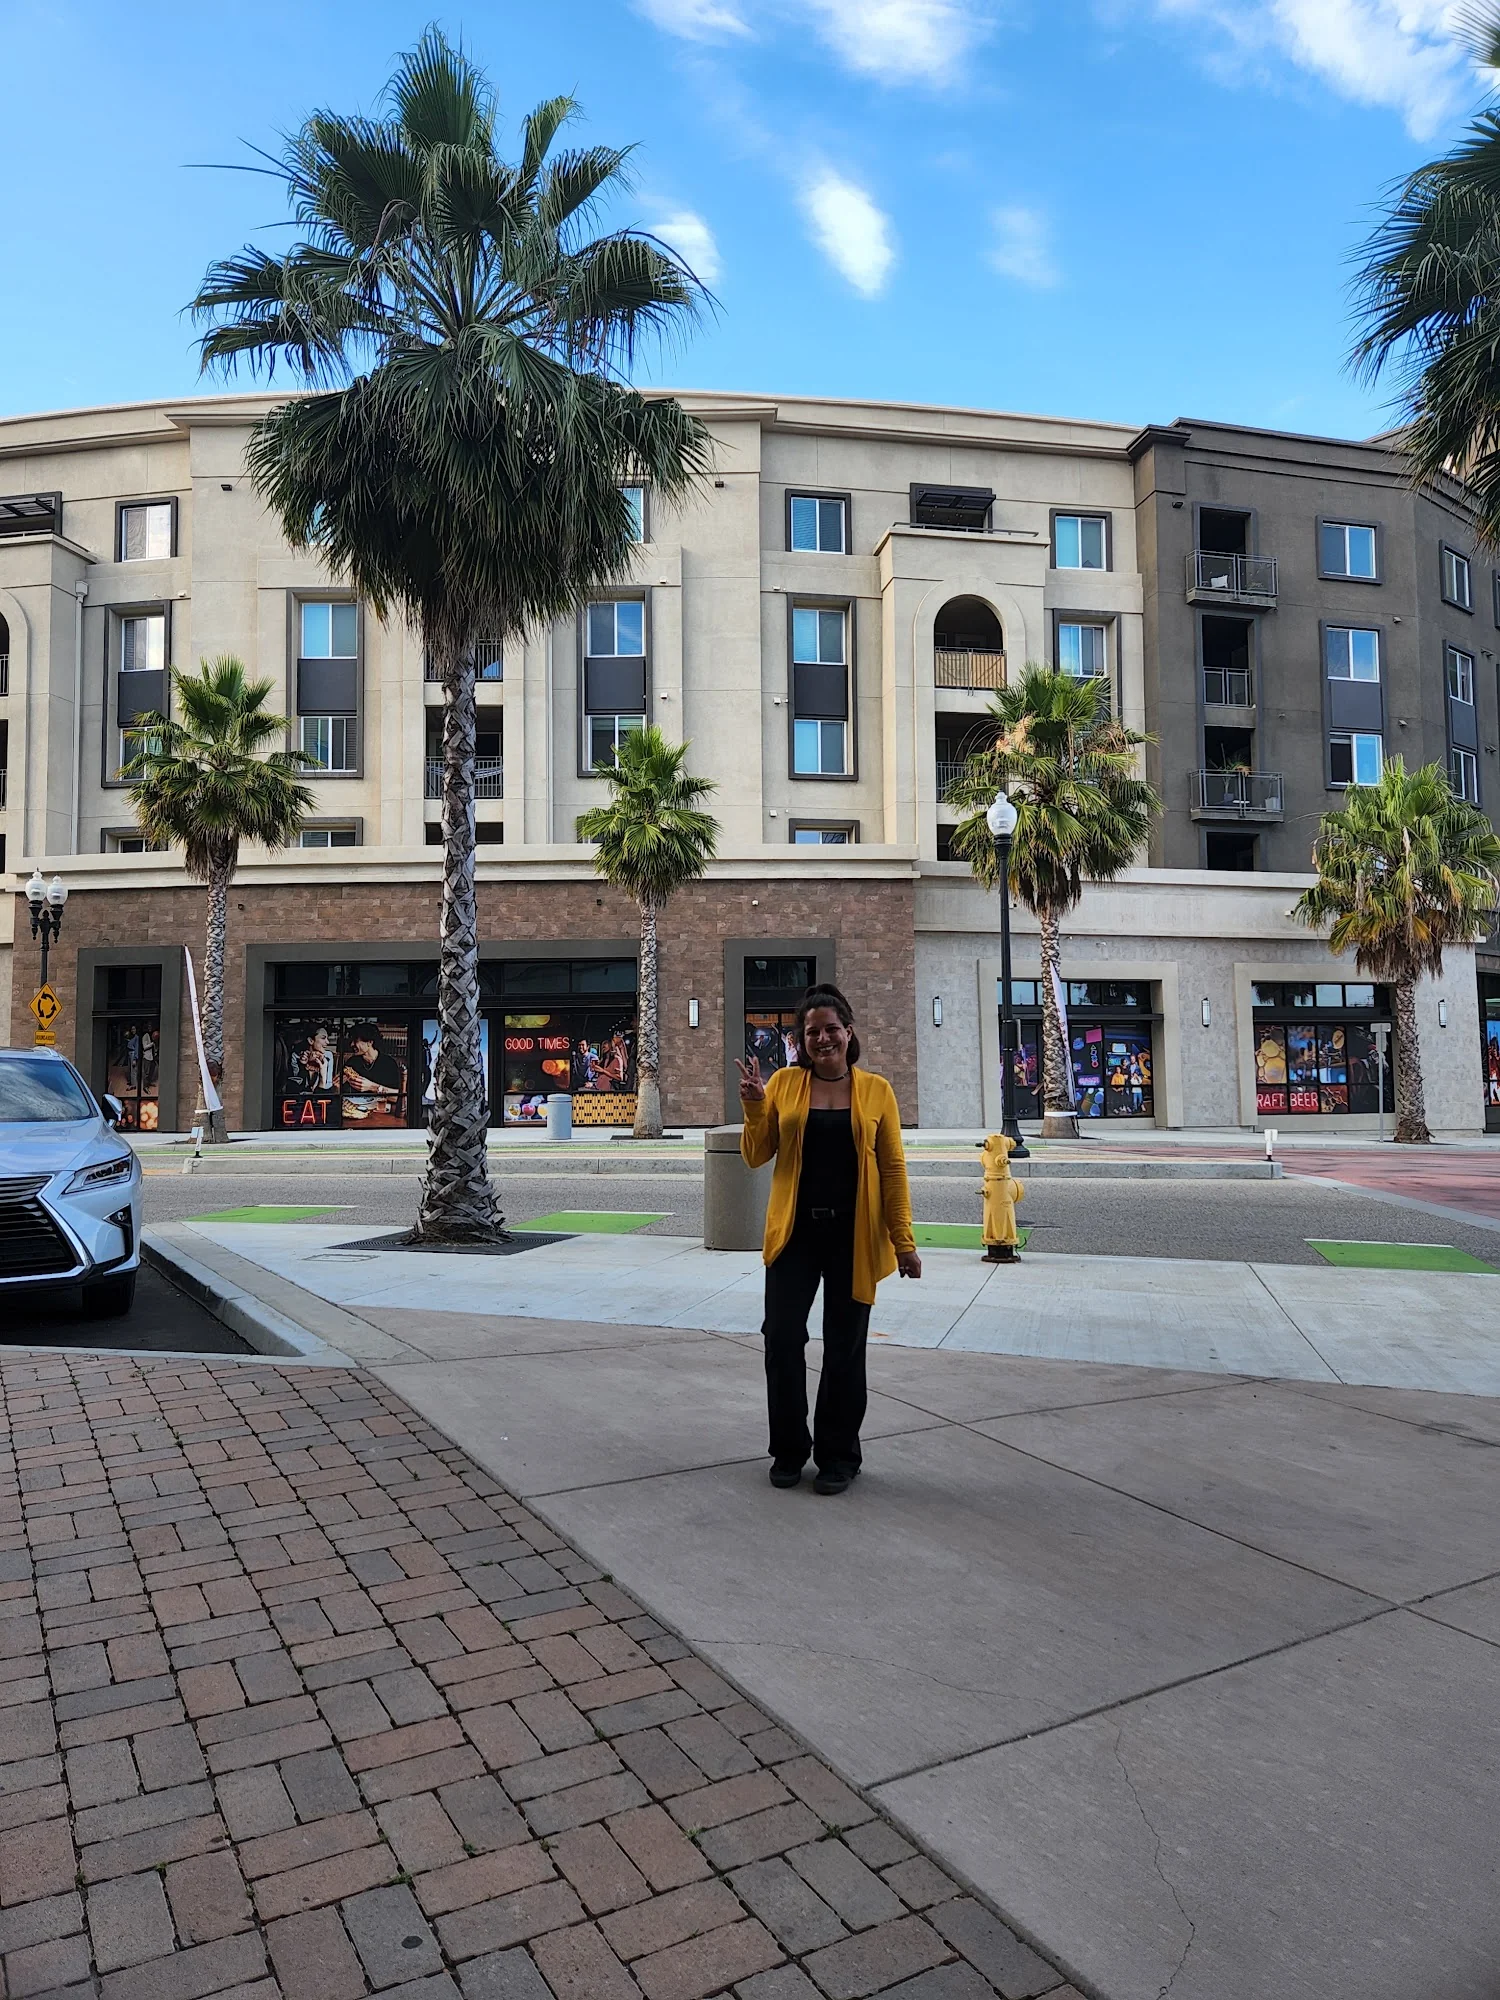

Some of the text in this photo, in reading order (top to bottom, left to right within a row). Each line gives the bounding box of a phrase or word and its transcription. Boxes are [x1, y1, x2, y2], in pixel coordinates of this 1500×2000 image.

[504, 1036, 570, 1050] GOOD TIMES
[1256, 1091, 1319, 1108] RAFT BEER
[283, 1099, 332, 1125] EAT
